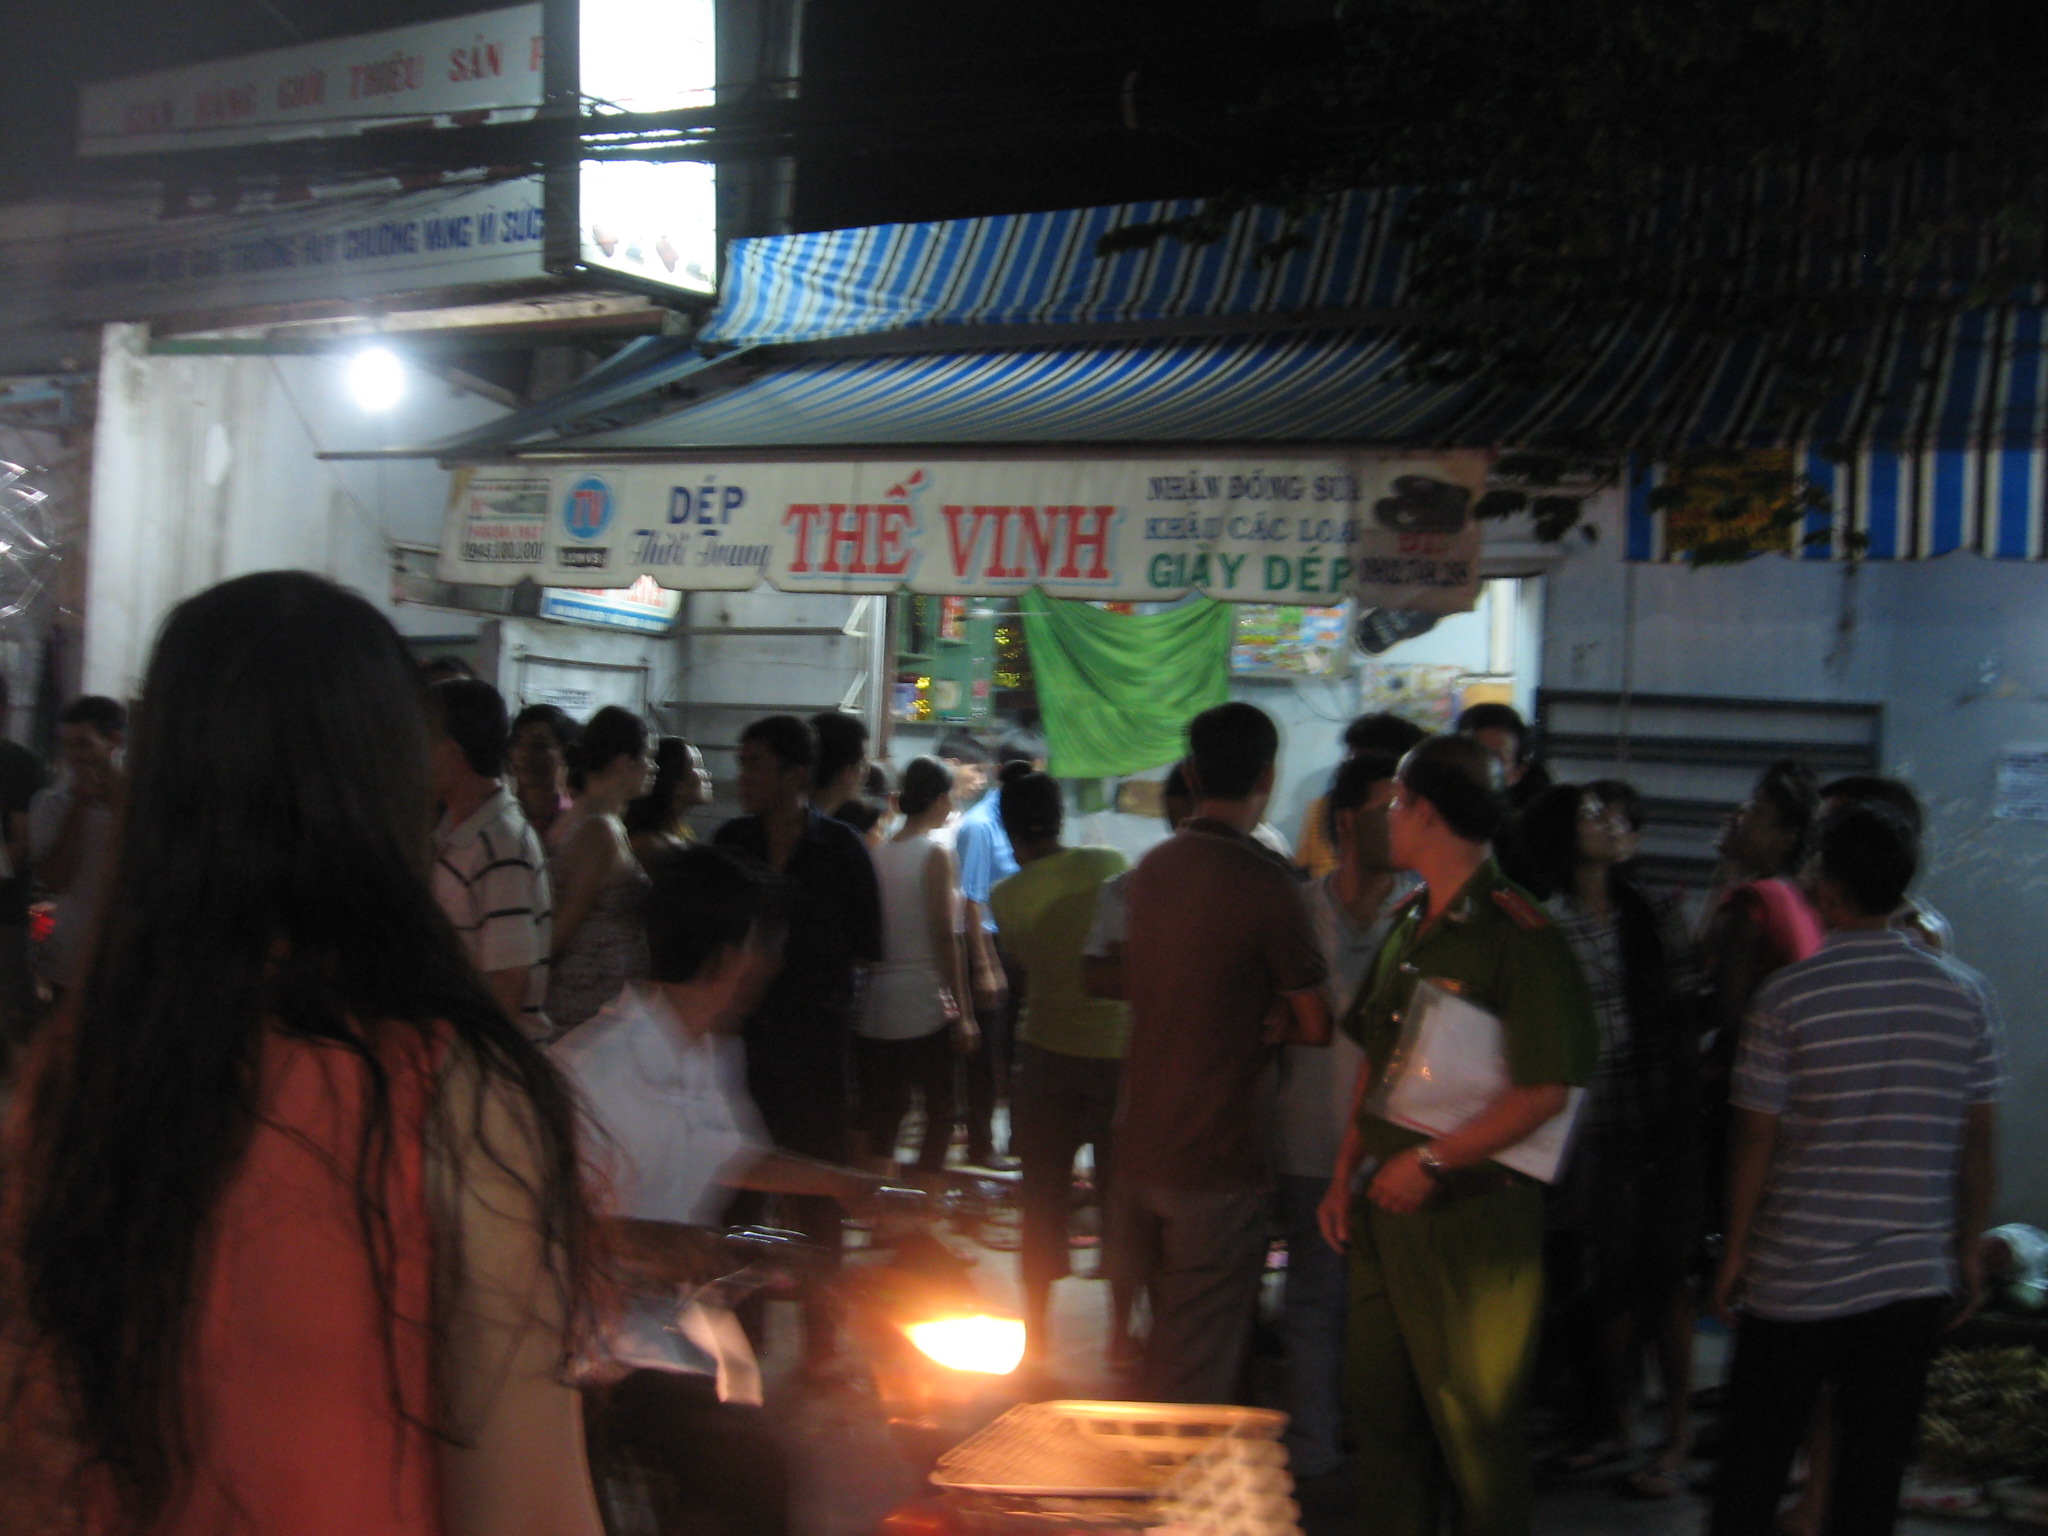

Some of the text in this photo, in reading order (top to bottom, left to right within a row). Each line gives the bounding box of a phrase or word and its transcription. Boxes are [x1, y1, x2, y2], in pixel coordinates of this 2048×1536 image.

[666, 475, 749, 525] DÉP
[778, 467, 1117, 578] THẾ VINH
[1227, 510, 1290, 542] CÁC
[1262, 545, 1355, 594] DÉP
